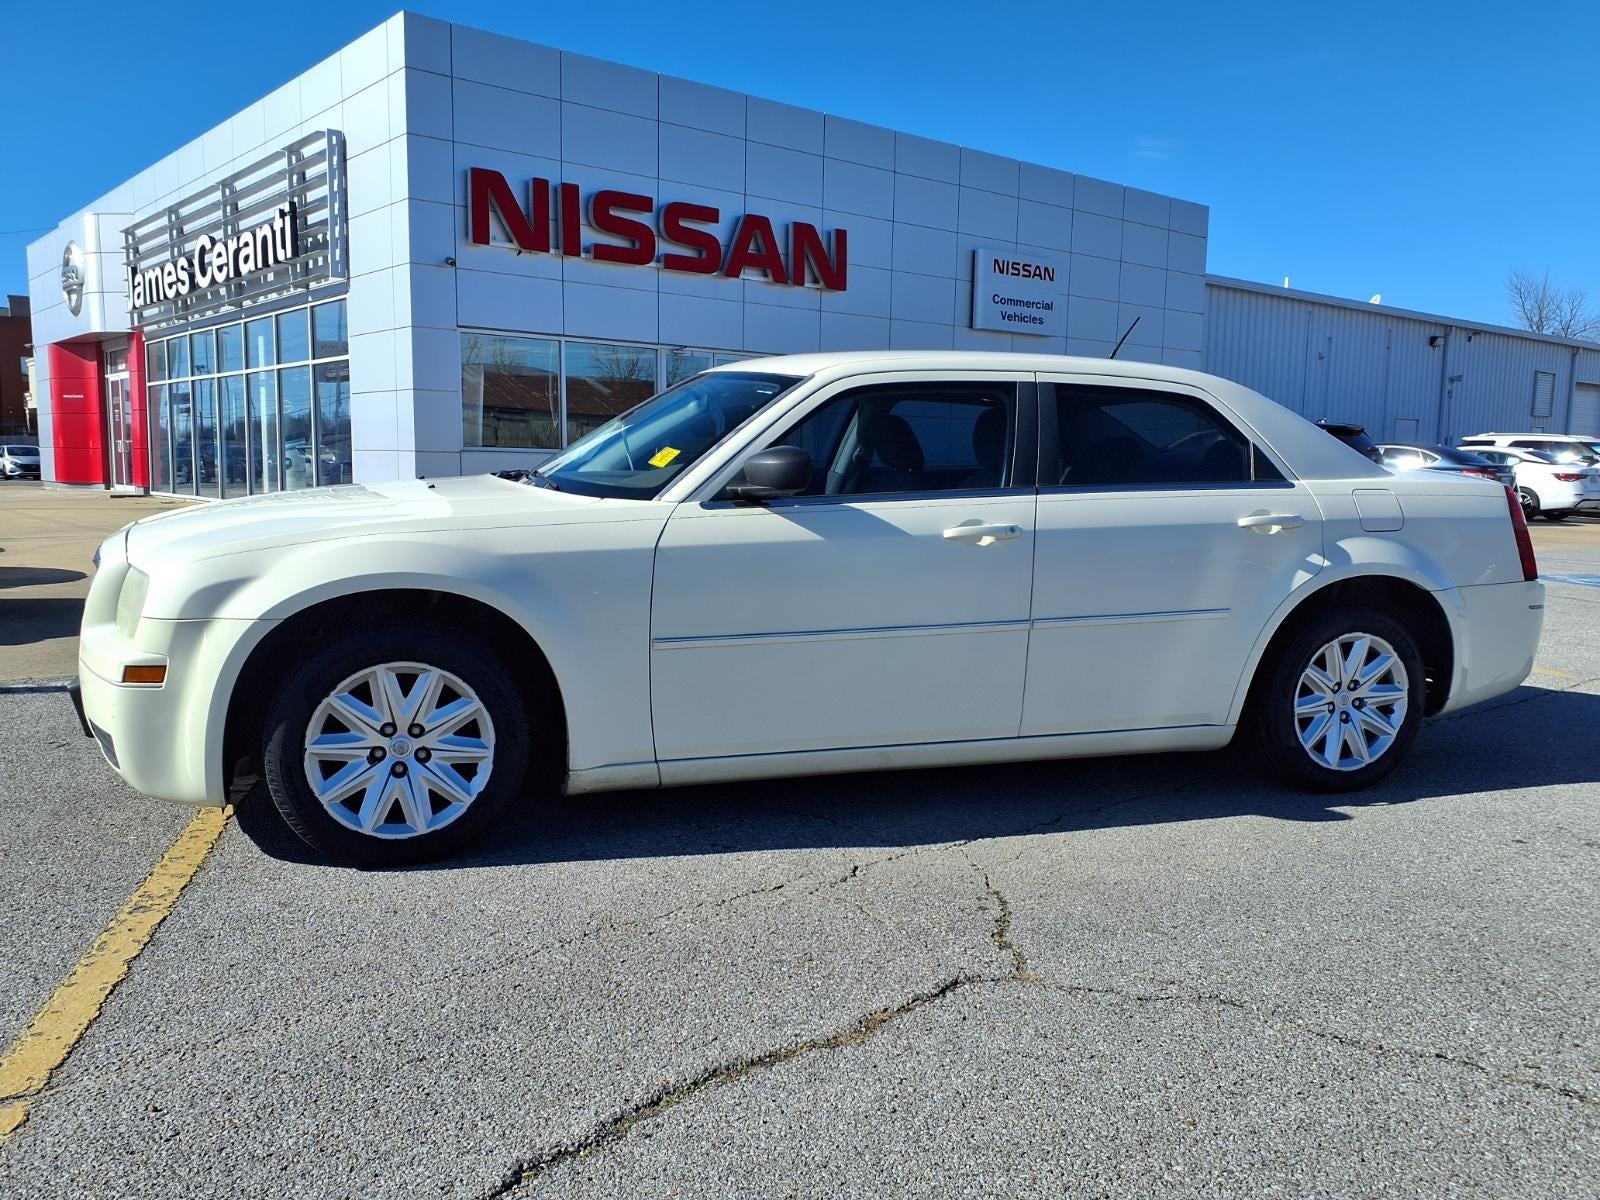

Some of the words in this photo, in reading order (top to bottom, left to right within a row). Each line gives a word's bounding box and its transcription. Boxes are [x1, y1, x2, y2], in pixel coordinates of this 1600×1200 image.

[468, 167, 848, 291] NISSAN
[127, 256, 190, 310] James
[194, 201, 295, 288] Ceranti
[993, 259, 1055, 281] NISSAN
[992, 293, 1053, 311] Commercial
[1000, 310, 1044, 325] Vehicles
